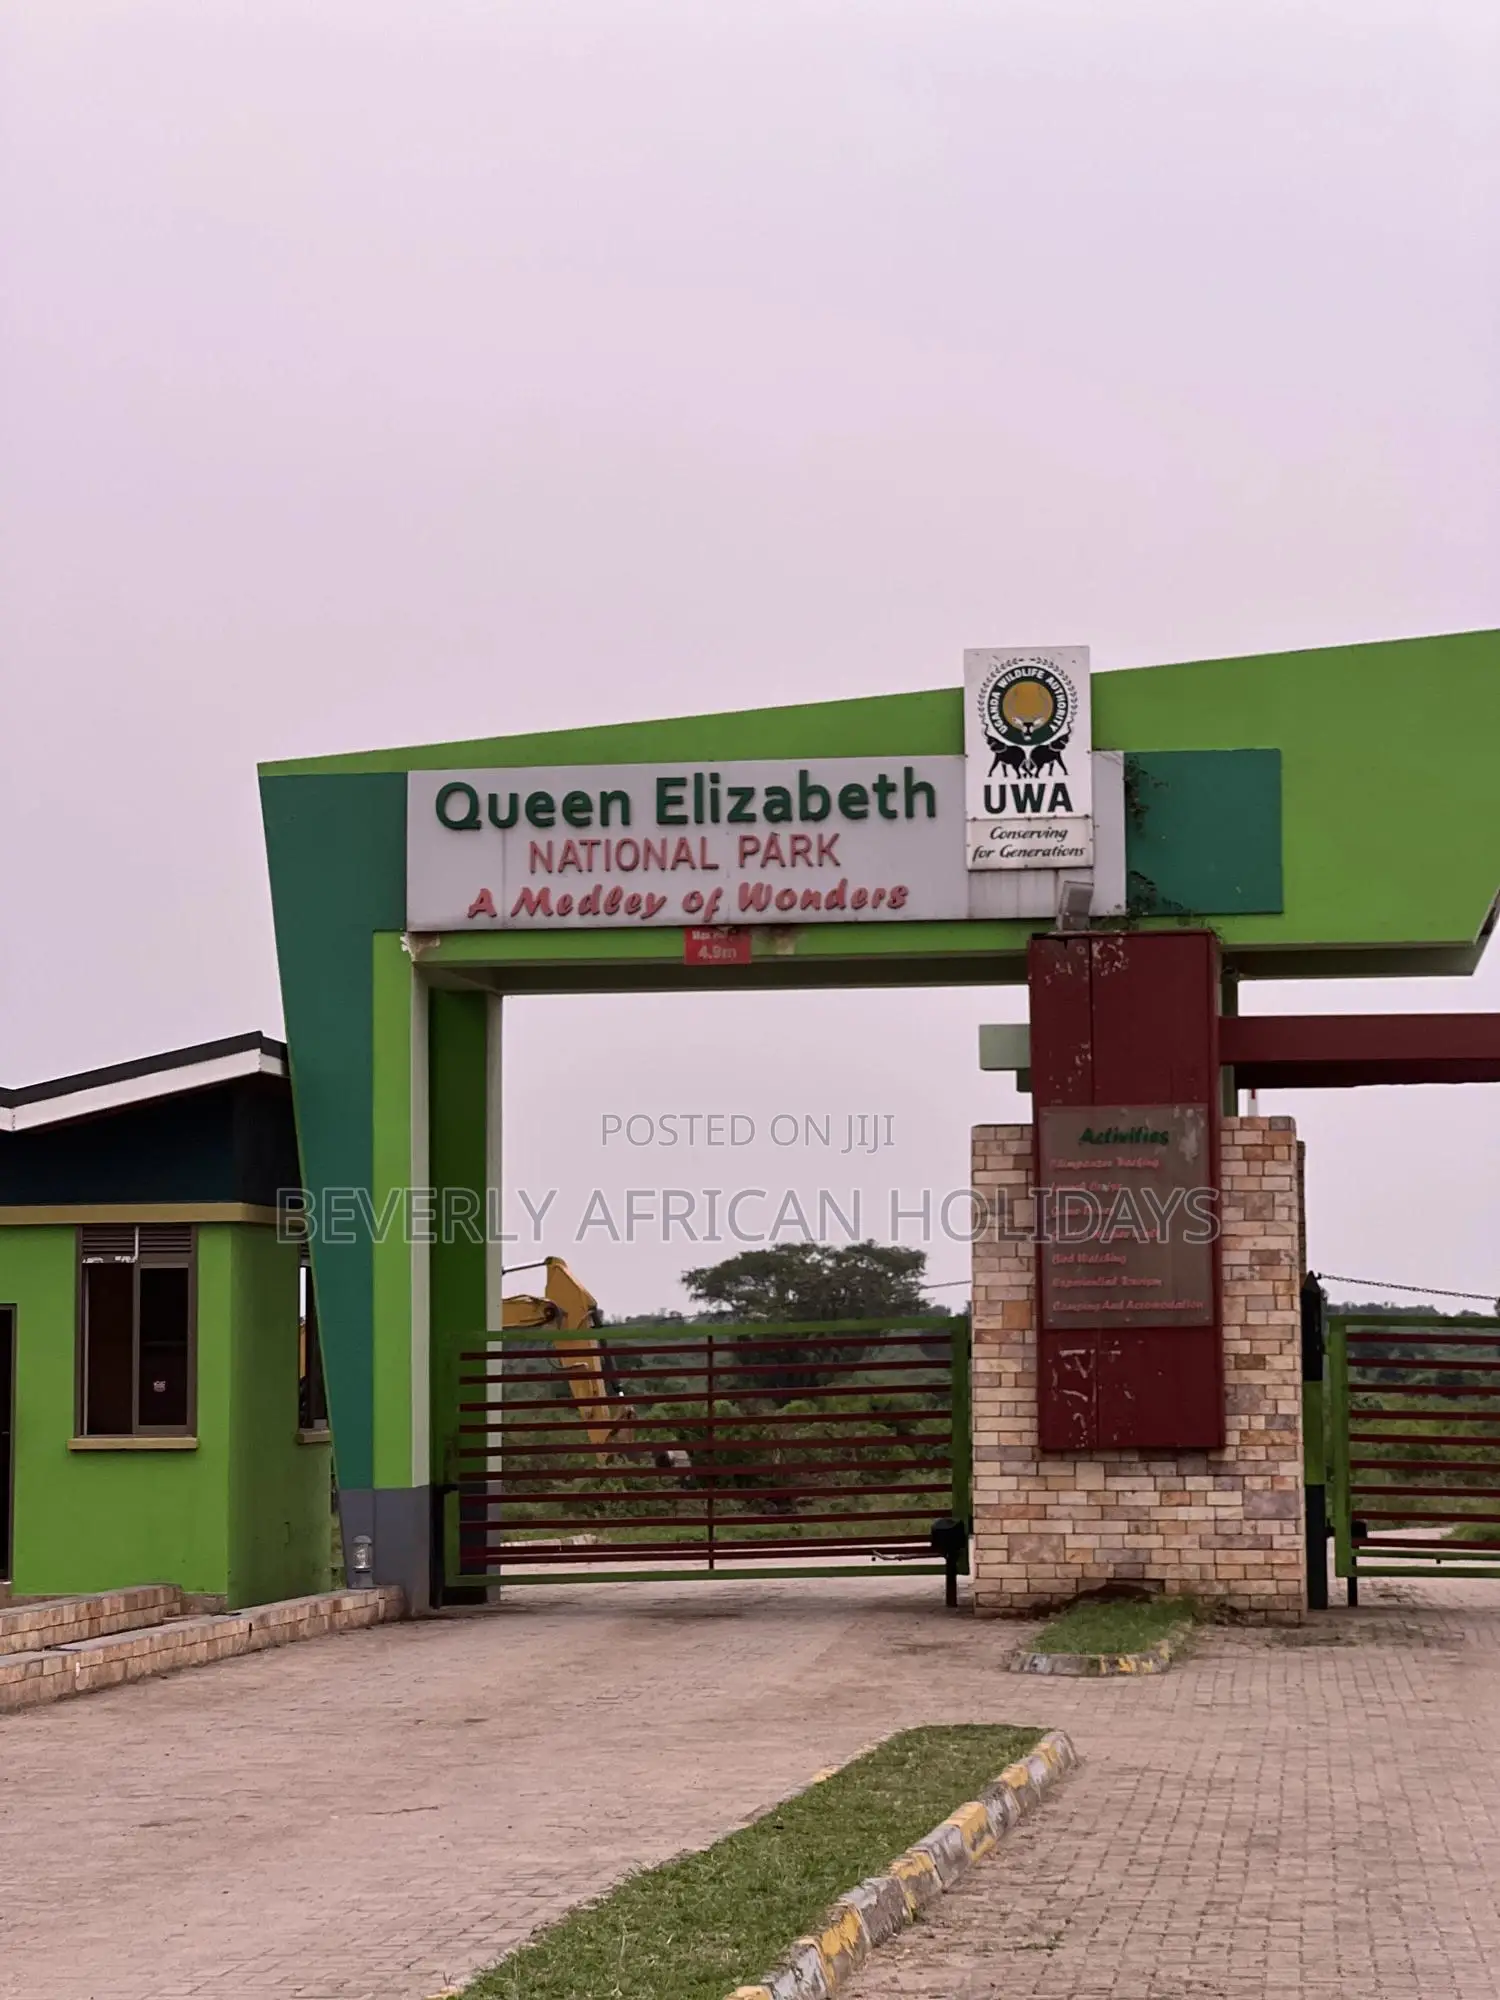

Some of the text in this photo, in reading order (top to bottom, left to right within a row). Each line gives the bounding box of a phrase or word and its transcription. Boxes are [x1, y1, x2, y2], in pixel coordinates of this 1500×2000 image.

[989, 668, 1067, 734] UGANDA WILDLIFE AUTHORITY
[435, 766, 937, 832] Queen Elizabeth
[983, 783, 1074, 815] UWA
[989, 825, 1069, 842] Conserving
[528, 832, 842, 875] NATIONAL PARK
[972, 844, 1087, 862] for Generations
[467, 878, 910, 922] A Medley of Wonders
[1078, 1126, 1170, 1146] Activities
